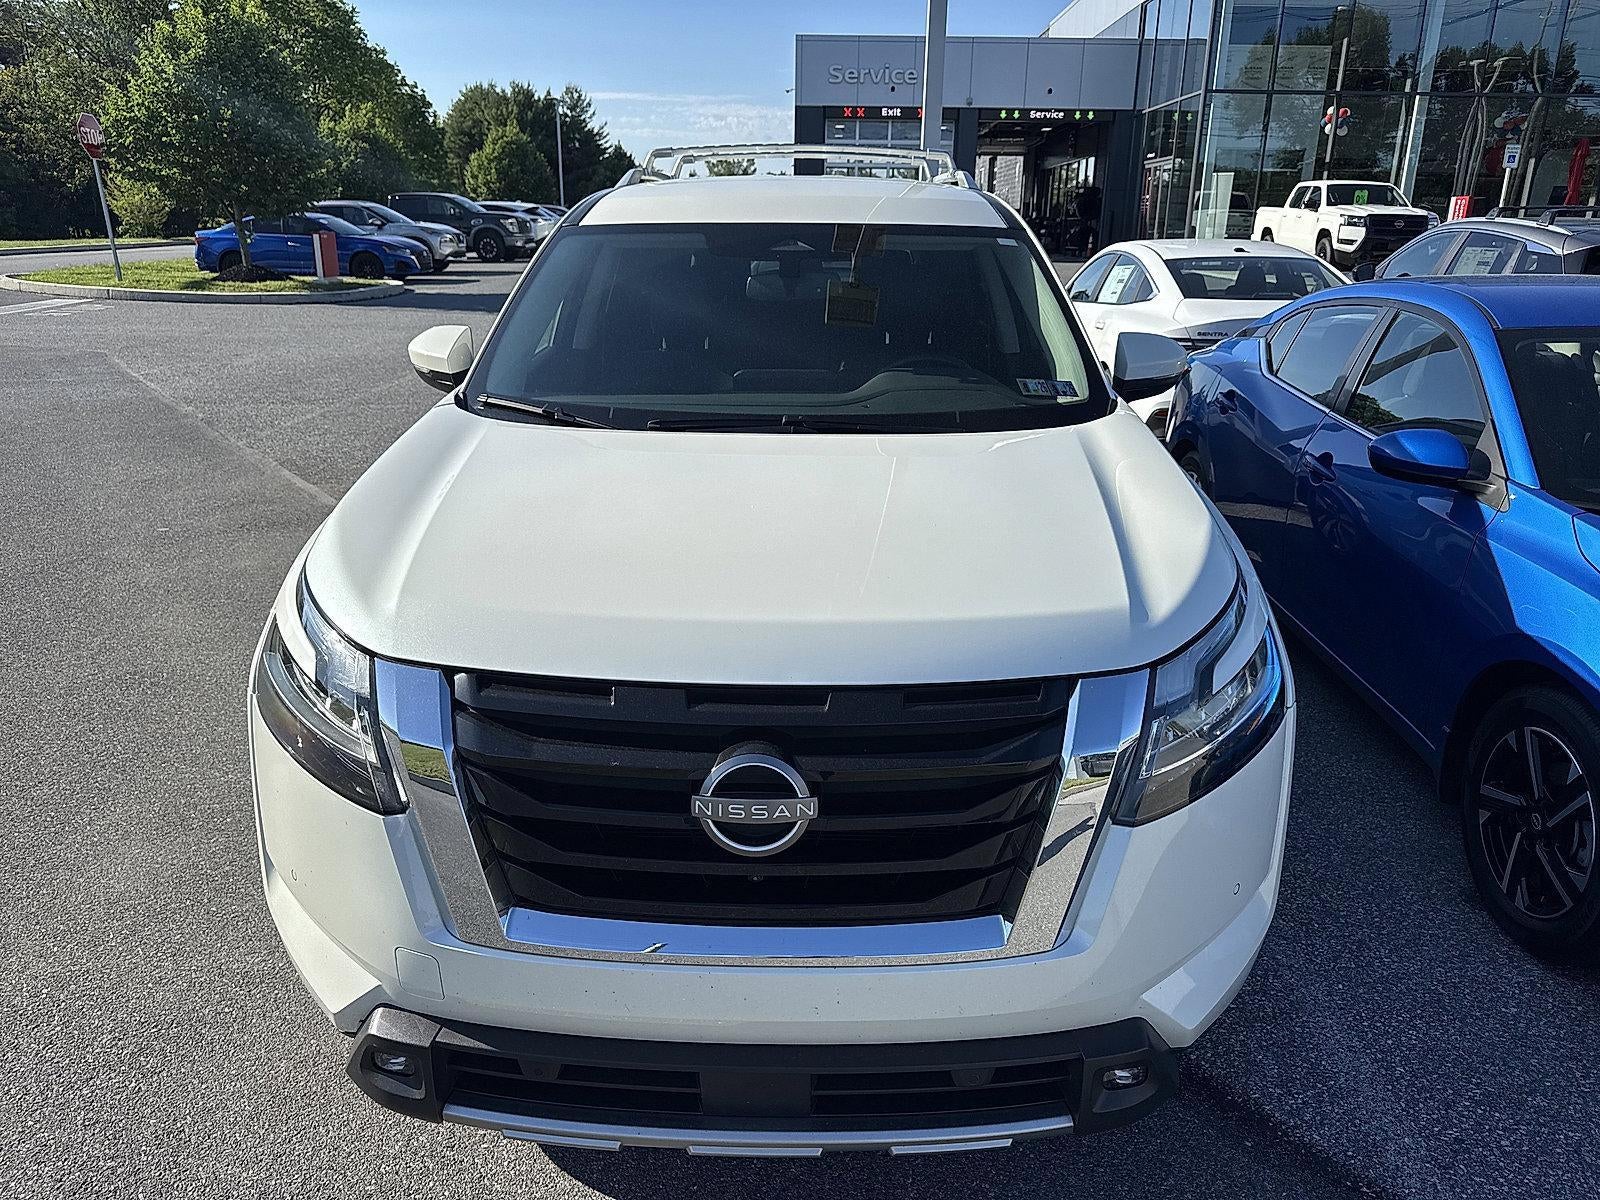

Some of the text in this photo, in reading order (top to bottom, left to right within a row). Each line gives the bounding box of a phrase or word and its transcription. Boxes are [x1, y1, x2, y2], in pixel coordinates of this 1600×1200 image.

[828, 63, 918, 85] Service
[881, 107, 902, 117] Exit
[1029, 109, 1065, 119] Service
[80, 126, 103, 145] STOP
[694, 800, 815, 820] NISSAN
